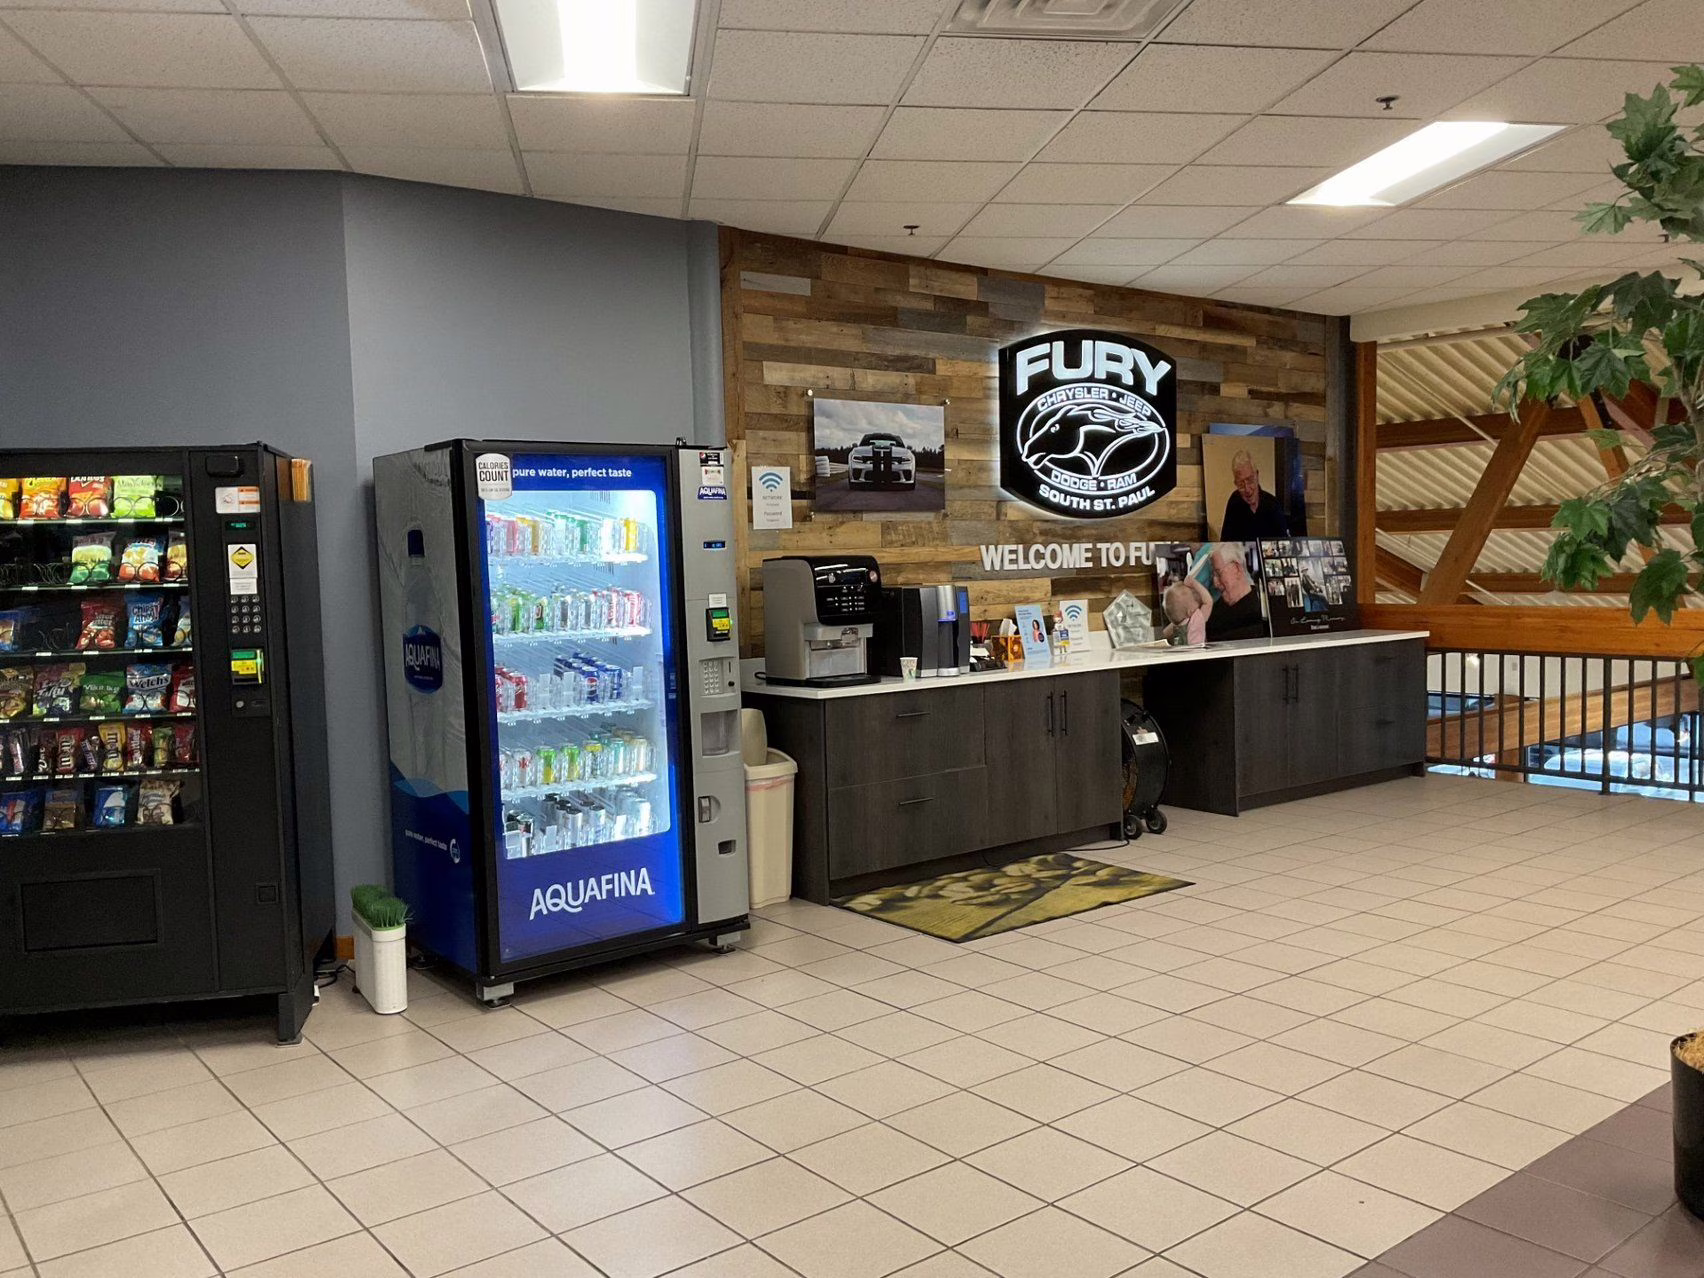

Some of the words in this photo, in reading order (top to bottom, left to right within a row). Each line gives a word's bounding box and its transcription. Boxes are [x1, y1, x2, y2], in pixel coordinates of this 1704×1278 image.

[1016, 339, 1172, 396] FURY
[1037, 387, 1110, 412] CHRYSLER
[1118, 393, 1152, 419] JEEP
[478, 462, 509, 470] CALORIES
[479, 470, 509, 482] COUNT
[512, 469, 536, 478] pure
[538, 468, 570, 479] water,
[571, 467, 607, 478] perfect
[608, 468, 632, 477] taste
[1051, 470, 1097, 491] DODGE
[1107, 472, 1137, 490] RAM
[1038, 483, 1091, 511] SOUTH
[1093, 497, 1116, 511] ST.
[1118, 485, 1156, 509] PAUL
[980, 542, 1094, 571] WELCOME
[1096, 541, 1126, 567] TO
[1129, 541, 1179, 566] FU
[405, 643, 440, 671] AQUAFINA
[529, 867, 655, 920] AQUAFINA
